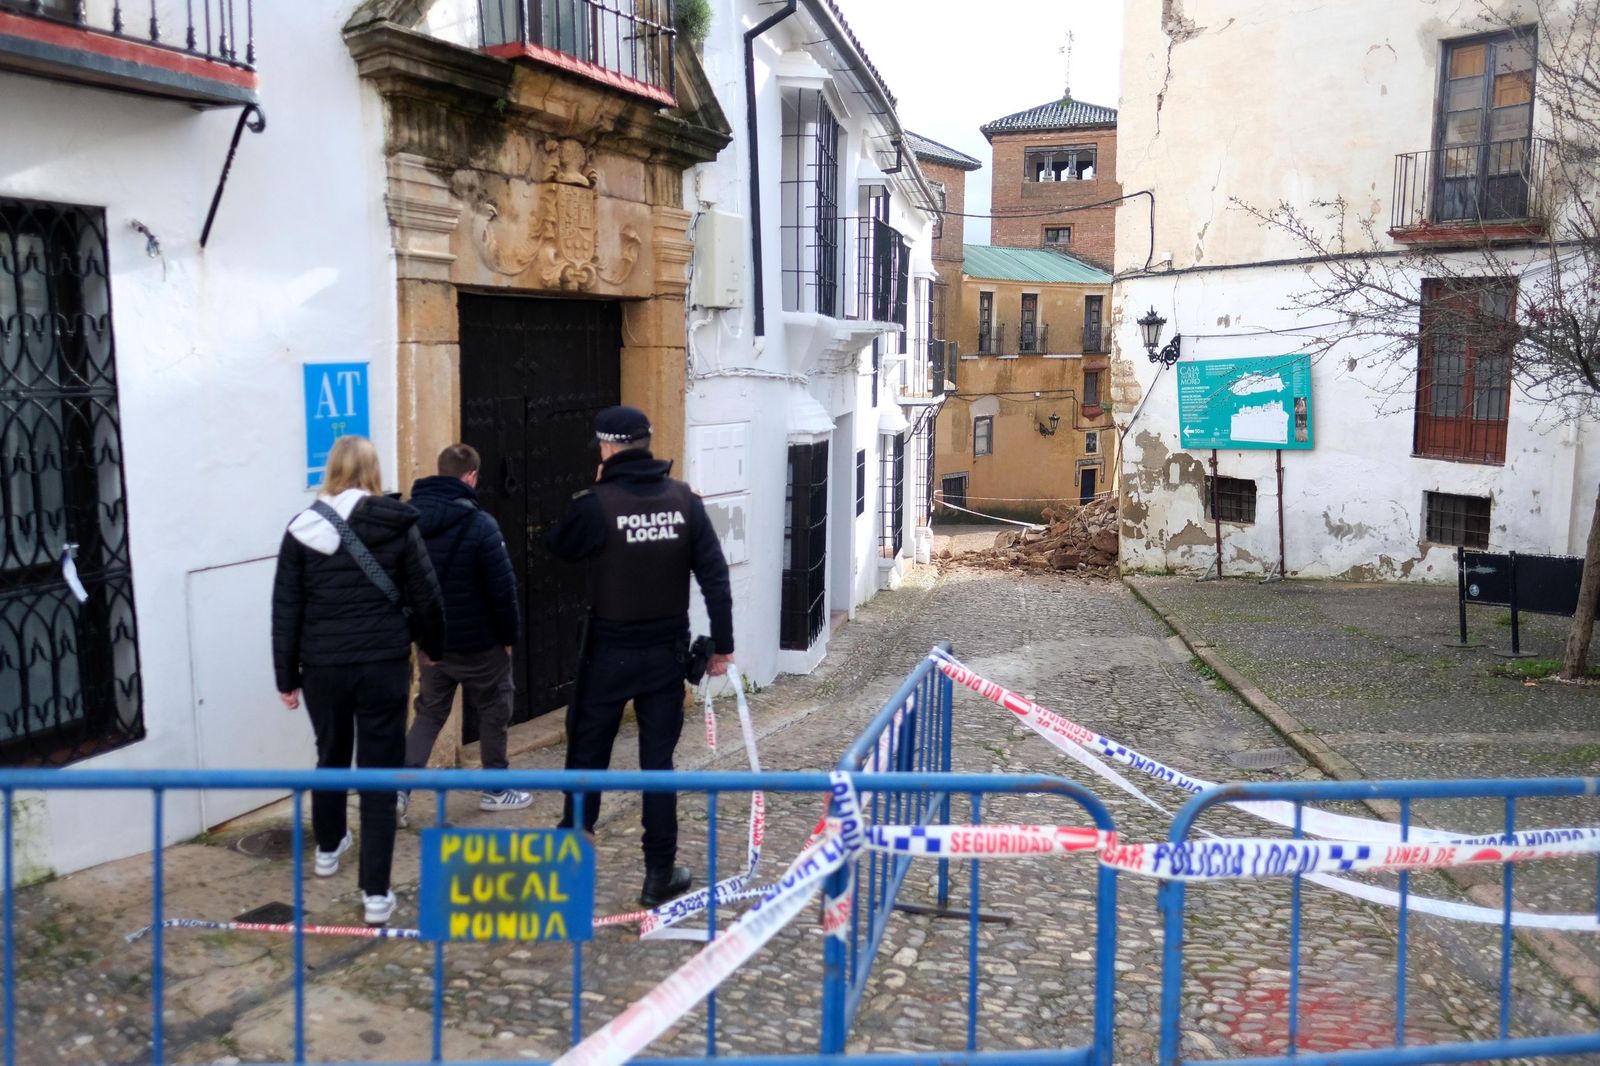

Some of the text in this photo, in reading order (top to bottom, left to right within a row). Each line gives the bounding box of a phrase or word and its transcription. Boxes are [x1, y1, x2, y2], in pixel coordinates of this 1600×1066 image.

[314, 371, 361, 419] AT
[616, 510, 686, 529] POLICIA
[626, 526, 679, 543] LOCAL
[439, 832, 582, 864] POLICIA
[949, 831, 1054, 855] SEGURIDAD
[1384, 847, 1457, 865] LINEA DE
[449, 871, 570, 905] LOCAL
